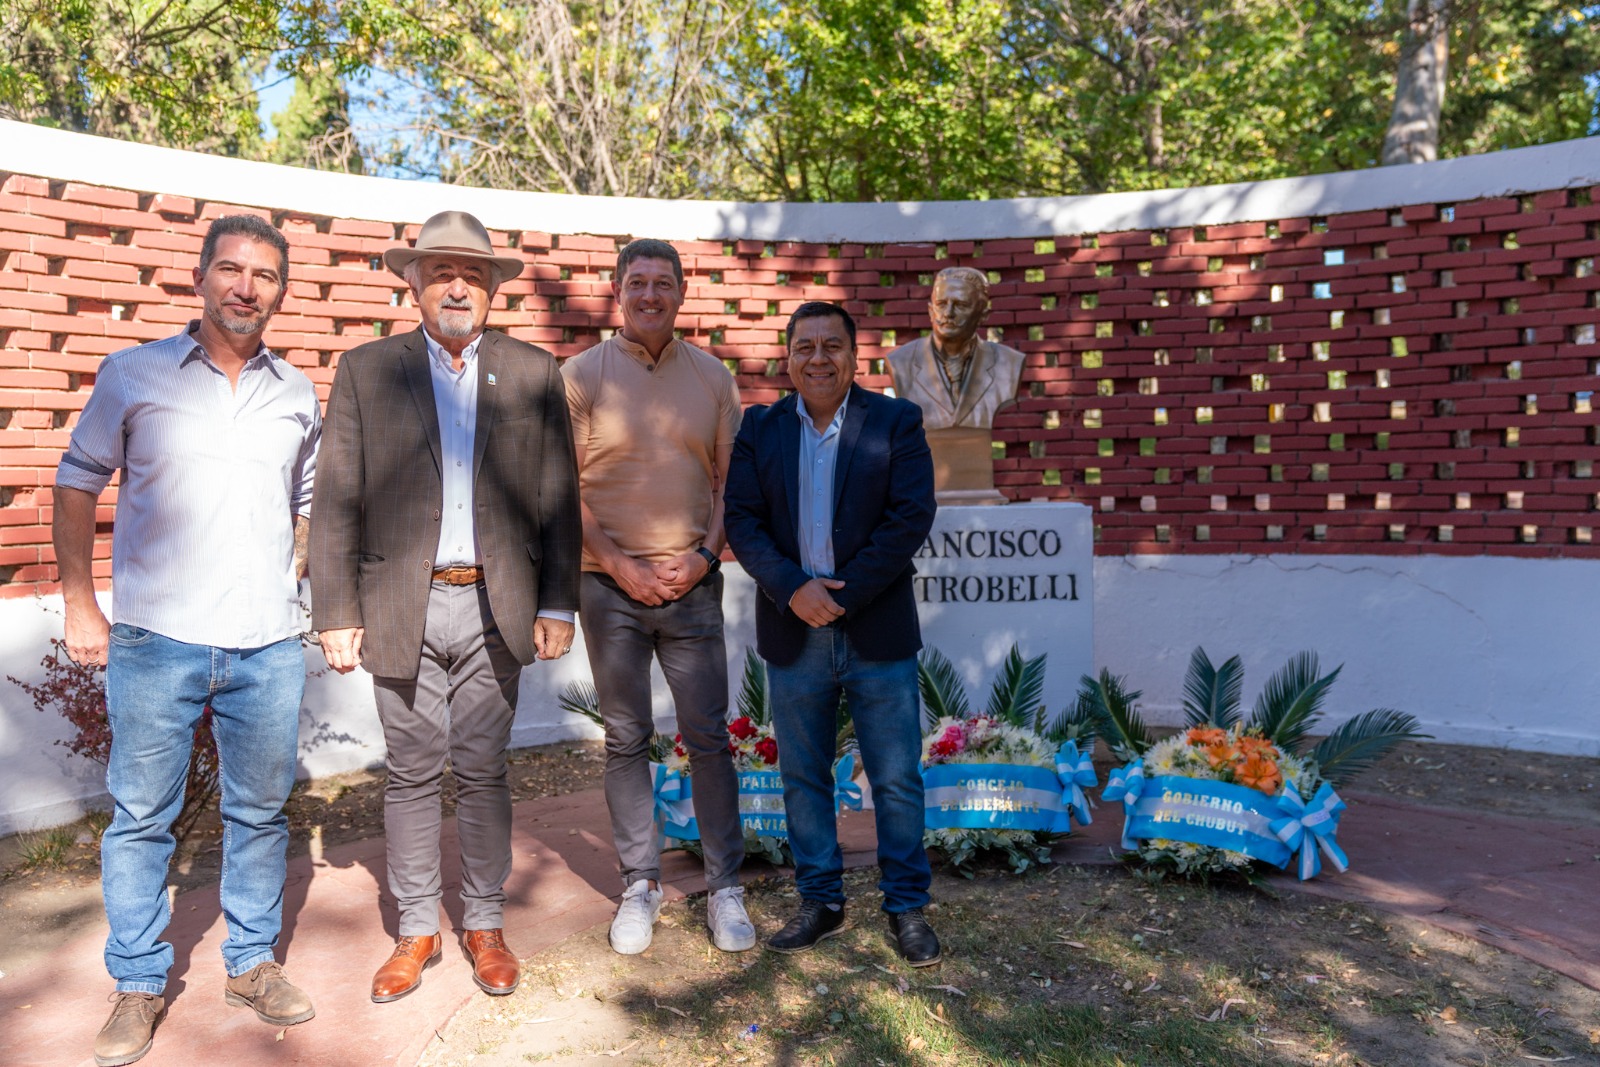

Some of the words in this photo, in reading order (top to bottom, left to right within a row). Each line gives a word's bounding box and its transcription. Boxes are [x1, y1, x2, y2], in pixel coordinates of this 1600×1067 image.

[914, 530, 1062, 558] ANCISCO
[914, 573, 1079, 601] TROBELLI
[957, 779, 1024, 792] CONCEJO
[940, 797, 1040, 813] DELIBERANTE
[1162, 790, 1243, 814] GOBIERNO
[1153, 809, 1181, 823] DEL
[1186, 813, 1248, 835] CHUBUT
